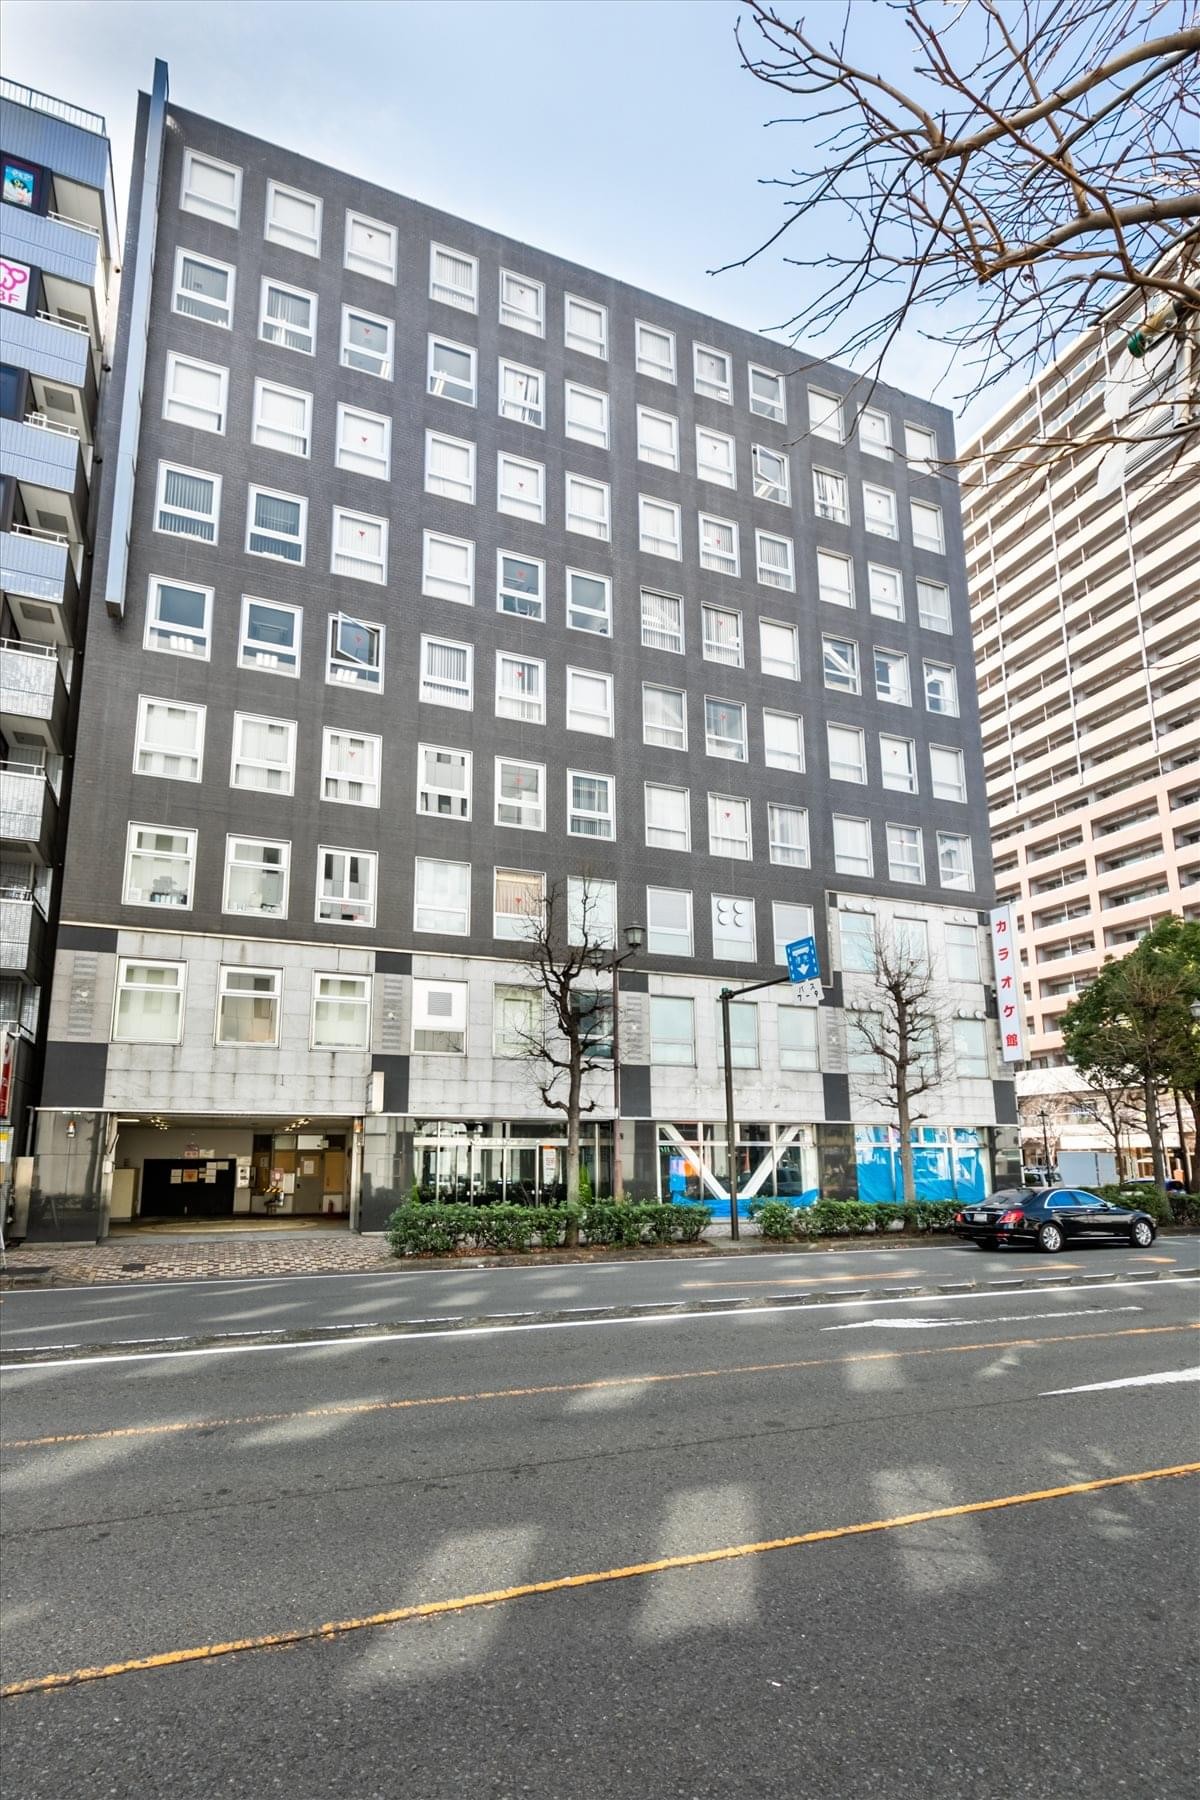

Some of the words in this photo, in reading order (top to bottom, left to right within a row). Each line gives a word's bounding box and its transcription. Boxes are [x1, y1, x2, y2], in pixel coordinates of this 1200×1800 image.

[996, 920, 1019, 1047] カラオケ館
